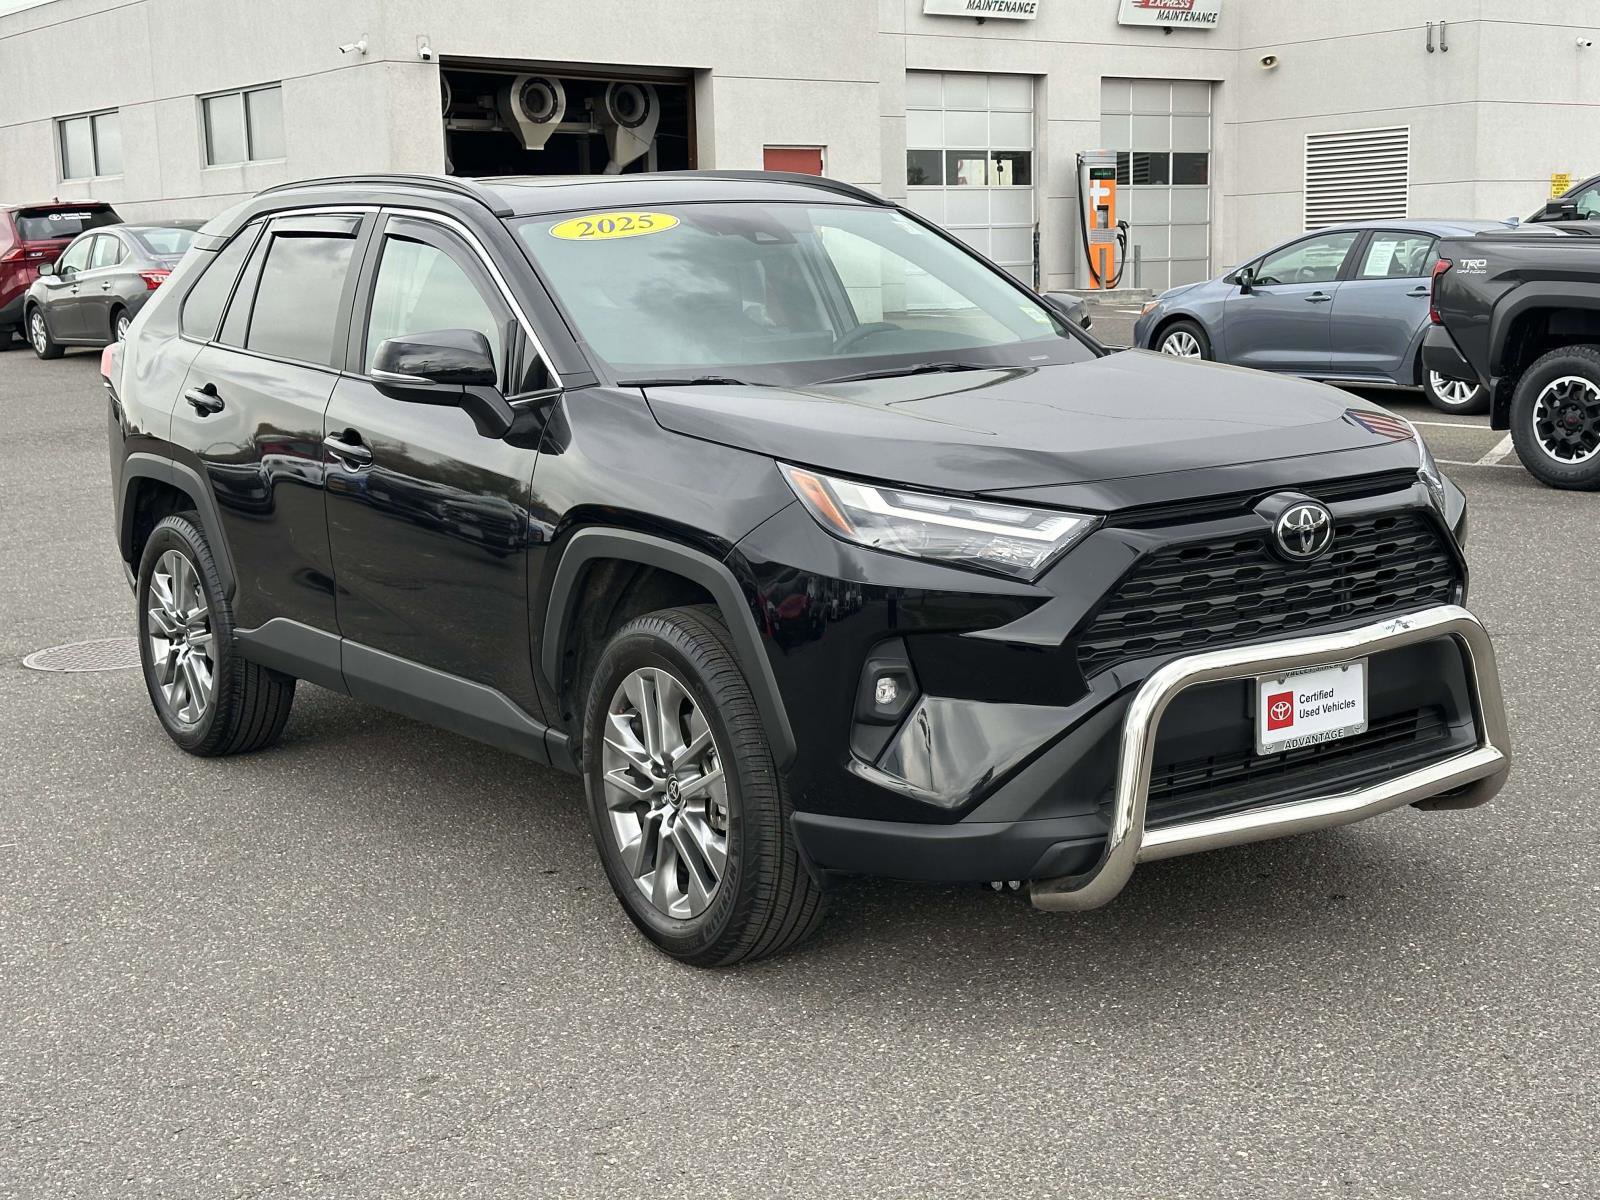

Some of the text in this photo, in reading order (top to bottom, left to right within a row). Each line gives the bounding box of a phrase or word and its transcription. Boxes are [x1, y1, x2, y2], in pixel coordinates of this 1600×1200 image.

[967, 0, 1036, 14] MAINTENANCE
[1156, 9, 1218, 23] MAINTENANCE
[576, 215, 654, 237] 2025
[1299, 688, 1334, 704] Certified
[1299, 699, 1356, 719] Used Vehicles
[1285, 729, 1344, 750] ADVANTAGE
